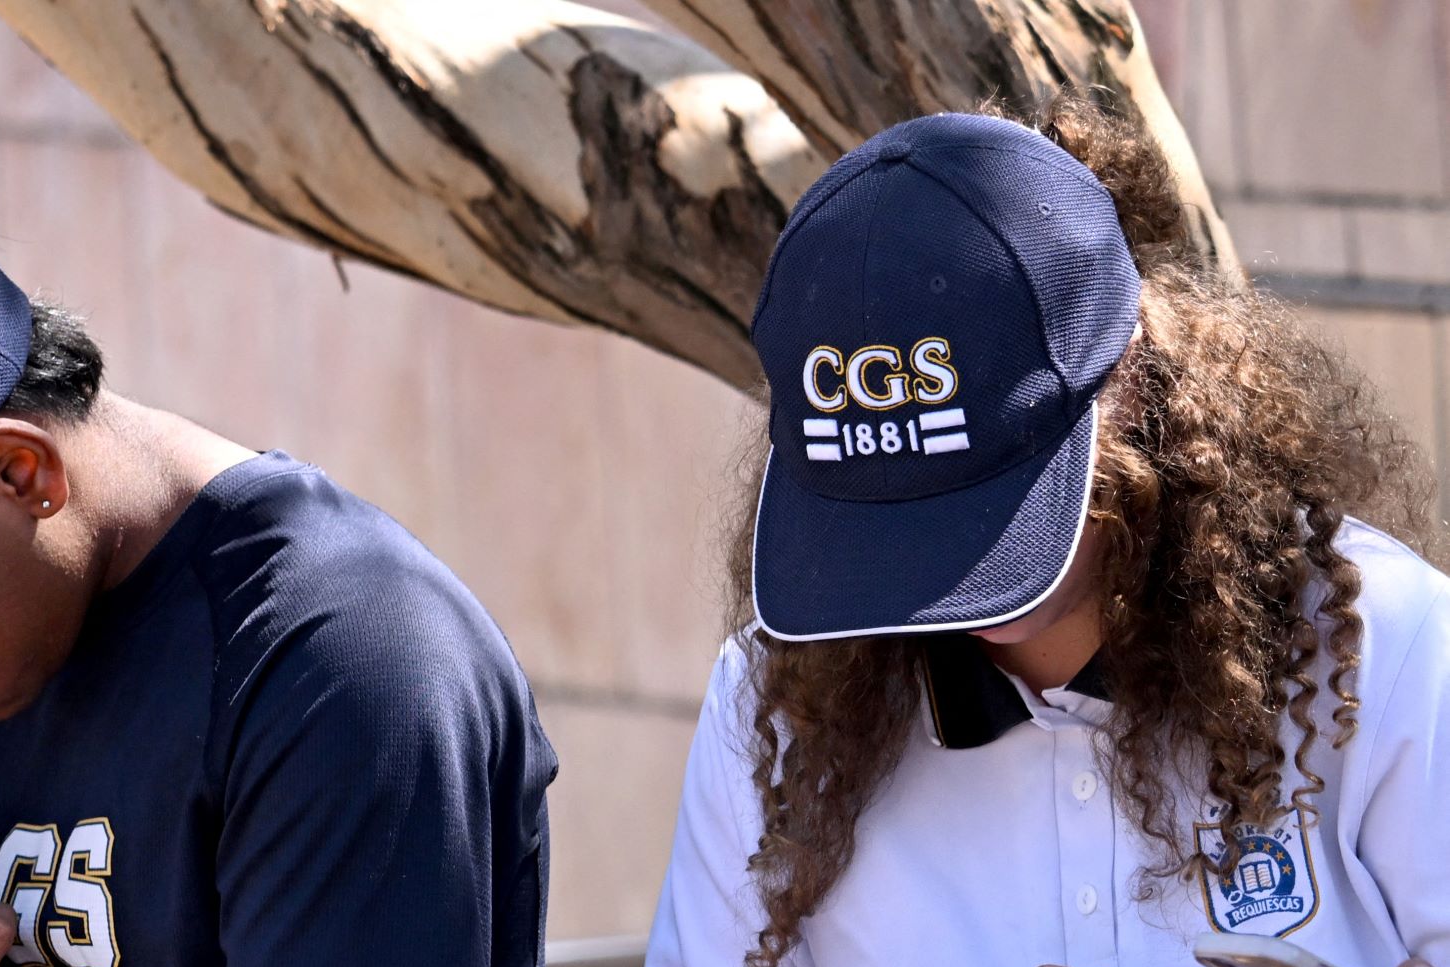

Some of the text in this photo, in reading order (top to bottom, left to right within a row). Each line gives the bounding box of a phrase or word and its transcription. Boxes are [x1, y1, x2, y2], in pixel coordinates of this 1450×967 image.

[802, 336, 959, 413] CGS
[842, 419, 919, 457] 1881
[1231, 897, 1302, 924] REQUIESCAS
